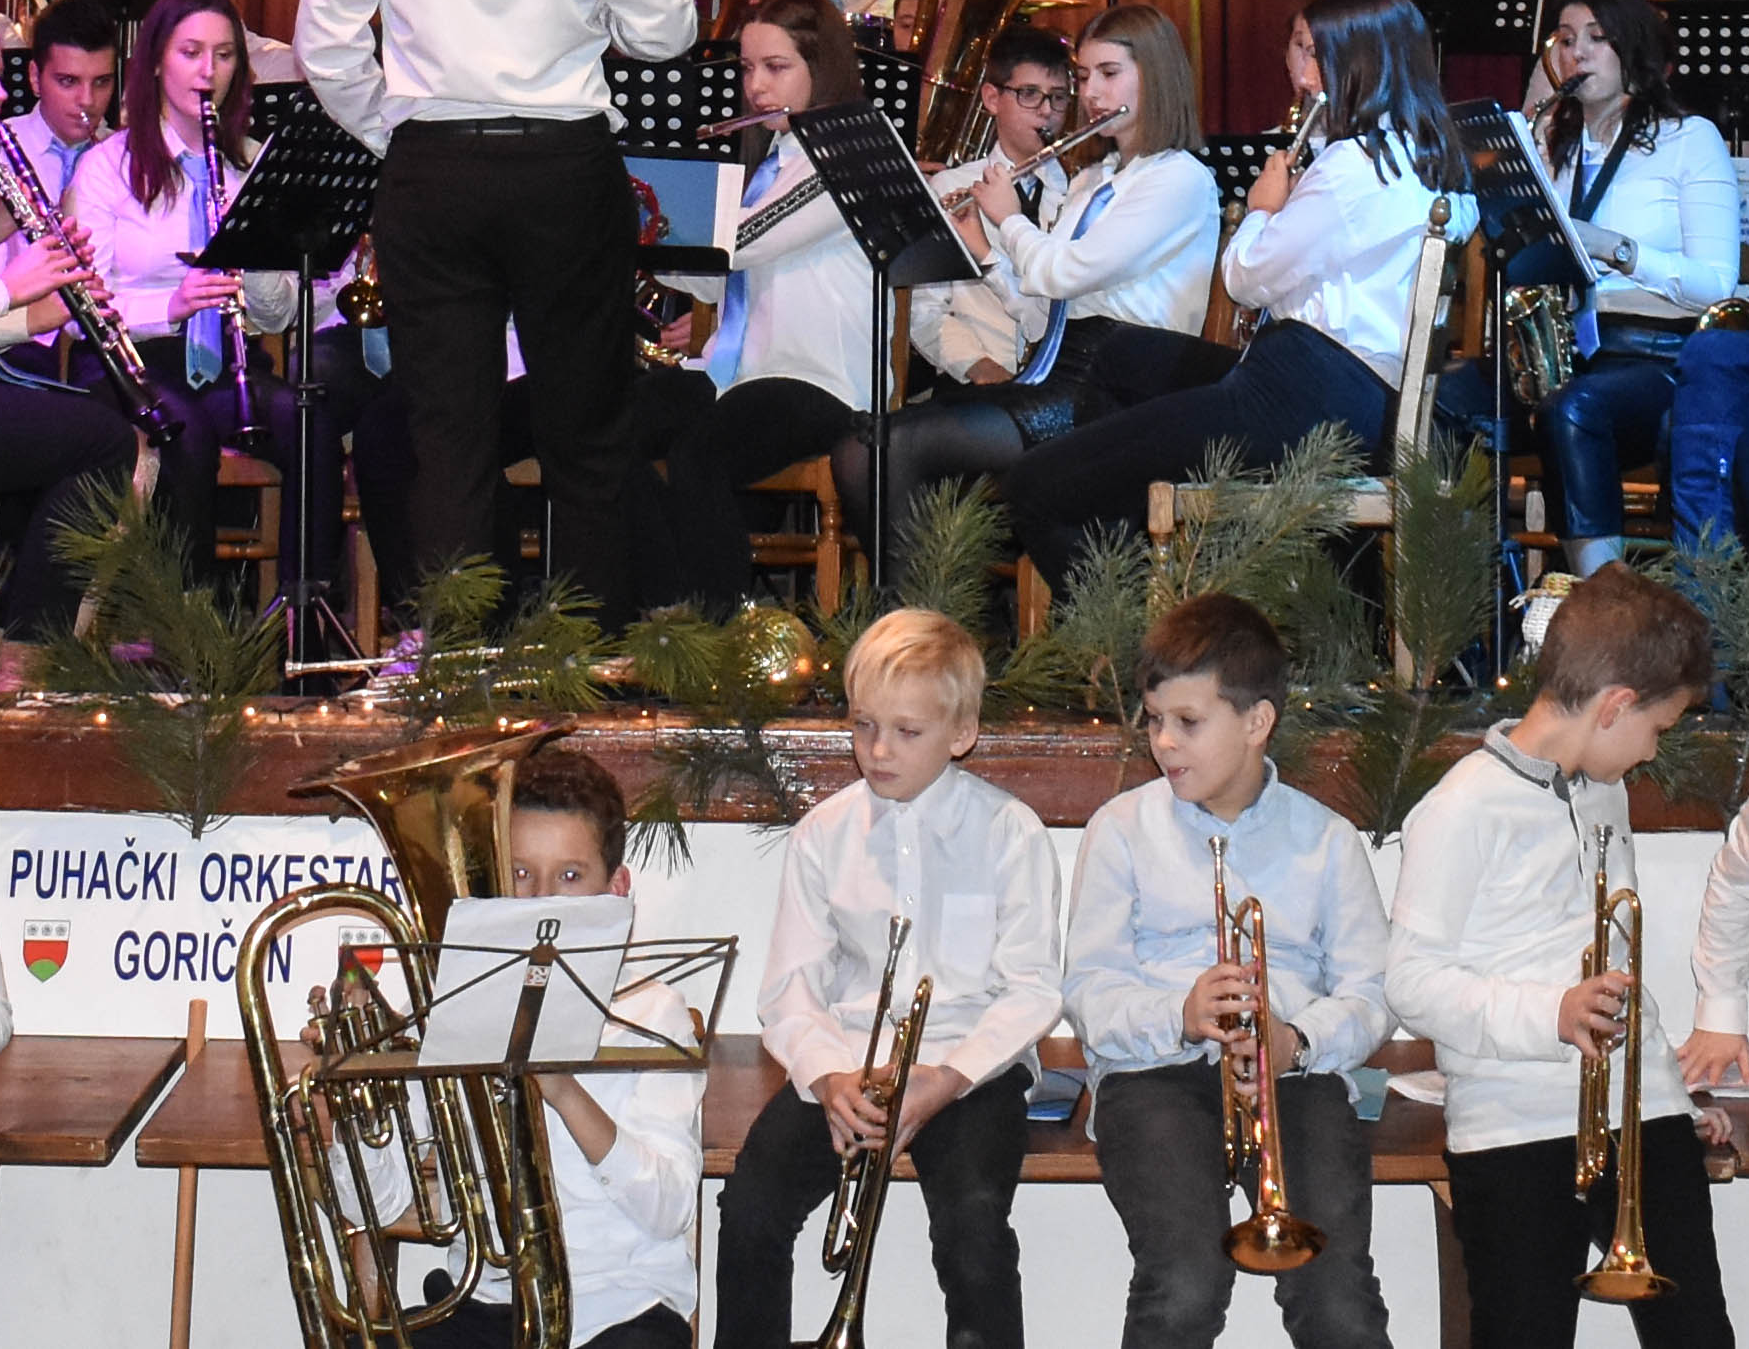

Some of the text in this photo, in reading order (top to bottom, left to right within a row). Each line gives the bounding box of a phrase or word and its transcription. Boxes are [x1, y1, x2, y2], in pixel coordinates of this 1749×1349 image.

[8, 837, 403, 905] PUHAČKI ORKESTAR
[114, 919, 292, 984] GORIČN
